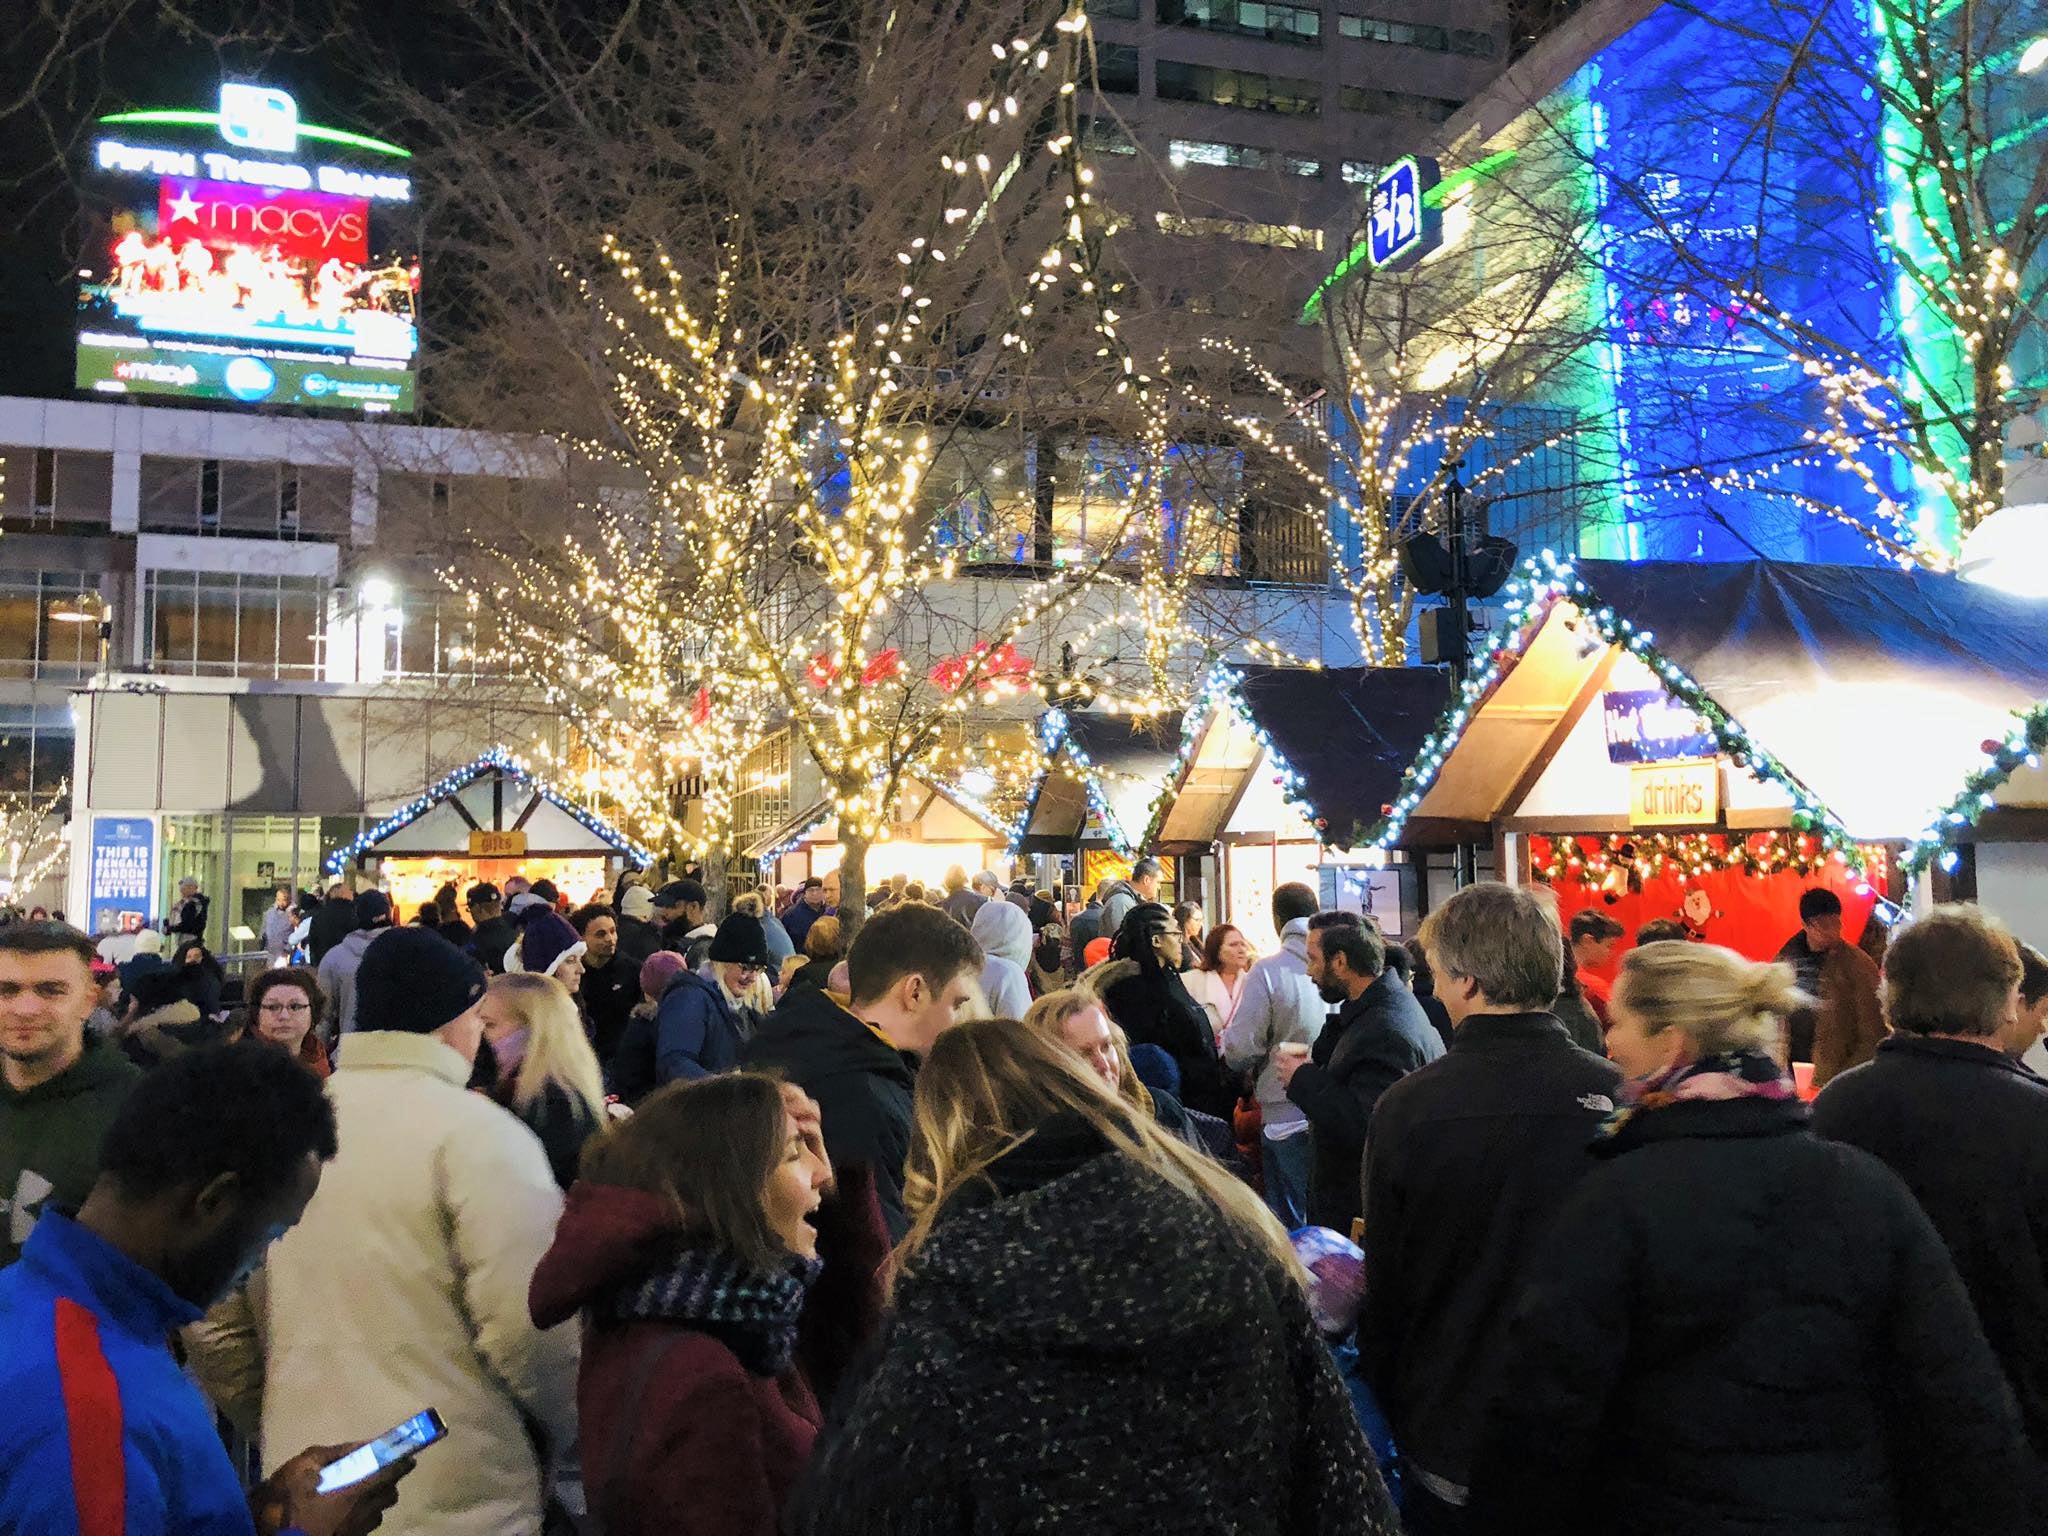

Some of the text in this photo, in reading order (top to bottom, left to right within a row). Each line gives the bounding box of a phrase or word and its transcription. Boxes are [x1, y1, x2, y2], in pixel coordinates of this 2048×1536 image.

[318, 166, 412, 201] BANK
[1643, 775, 1703, 816] drinks
[481, 835, 512, 853] gifts
[97, 846, 148, 858] THIS IS
[96, 858, 148, 868] BENGALS
[95, 868, 147, 879] FANDOM
[94, 886, 147, 898] BETTER
